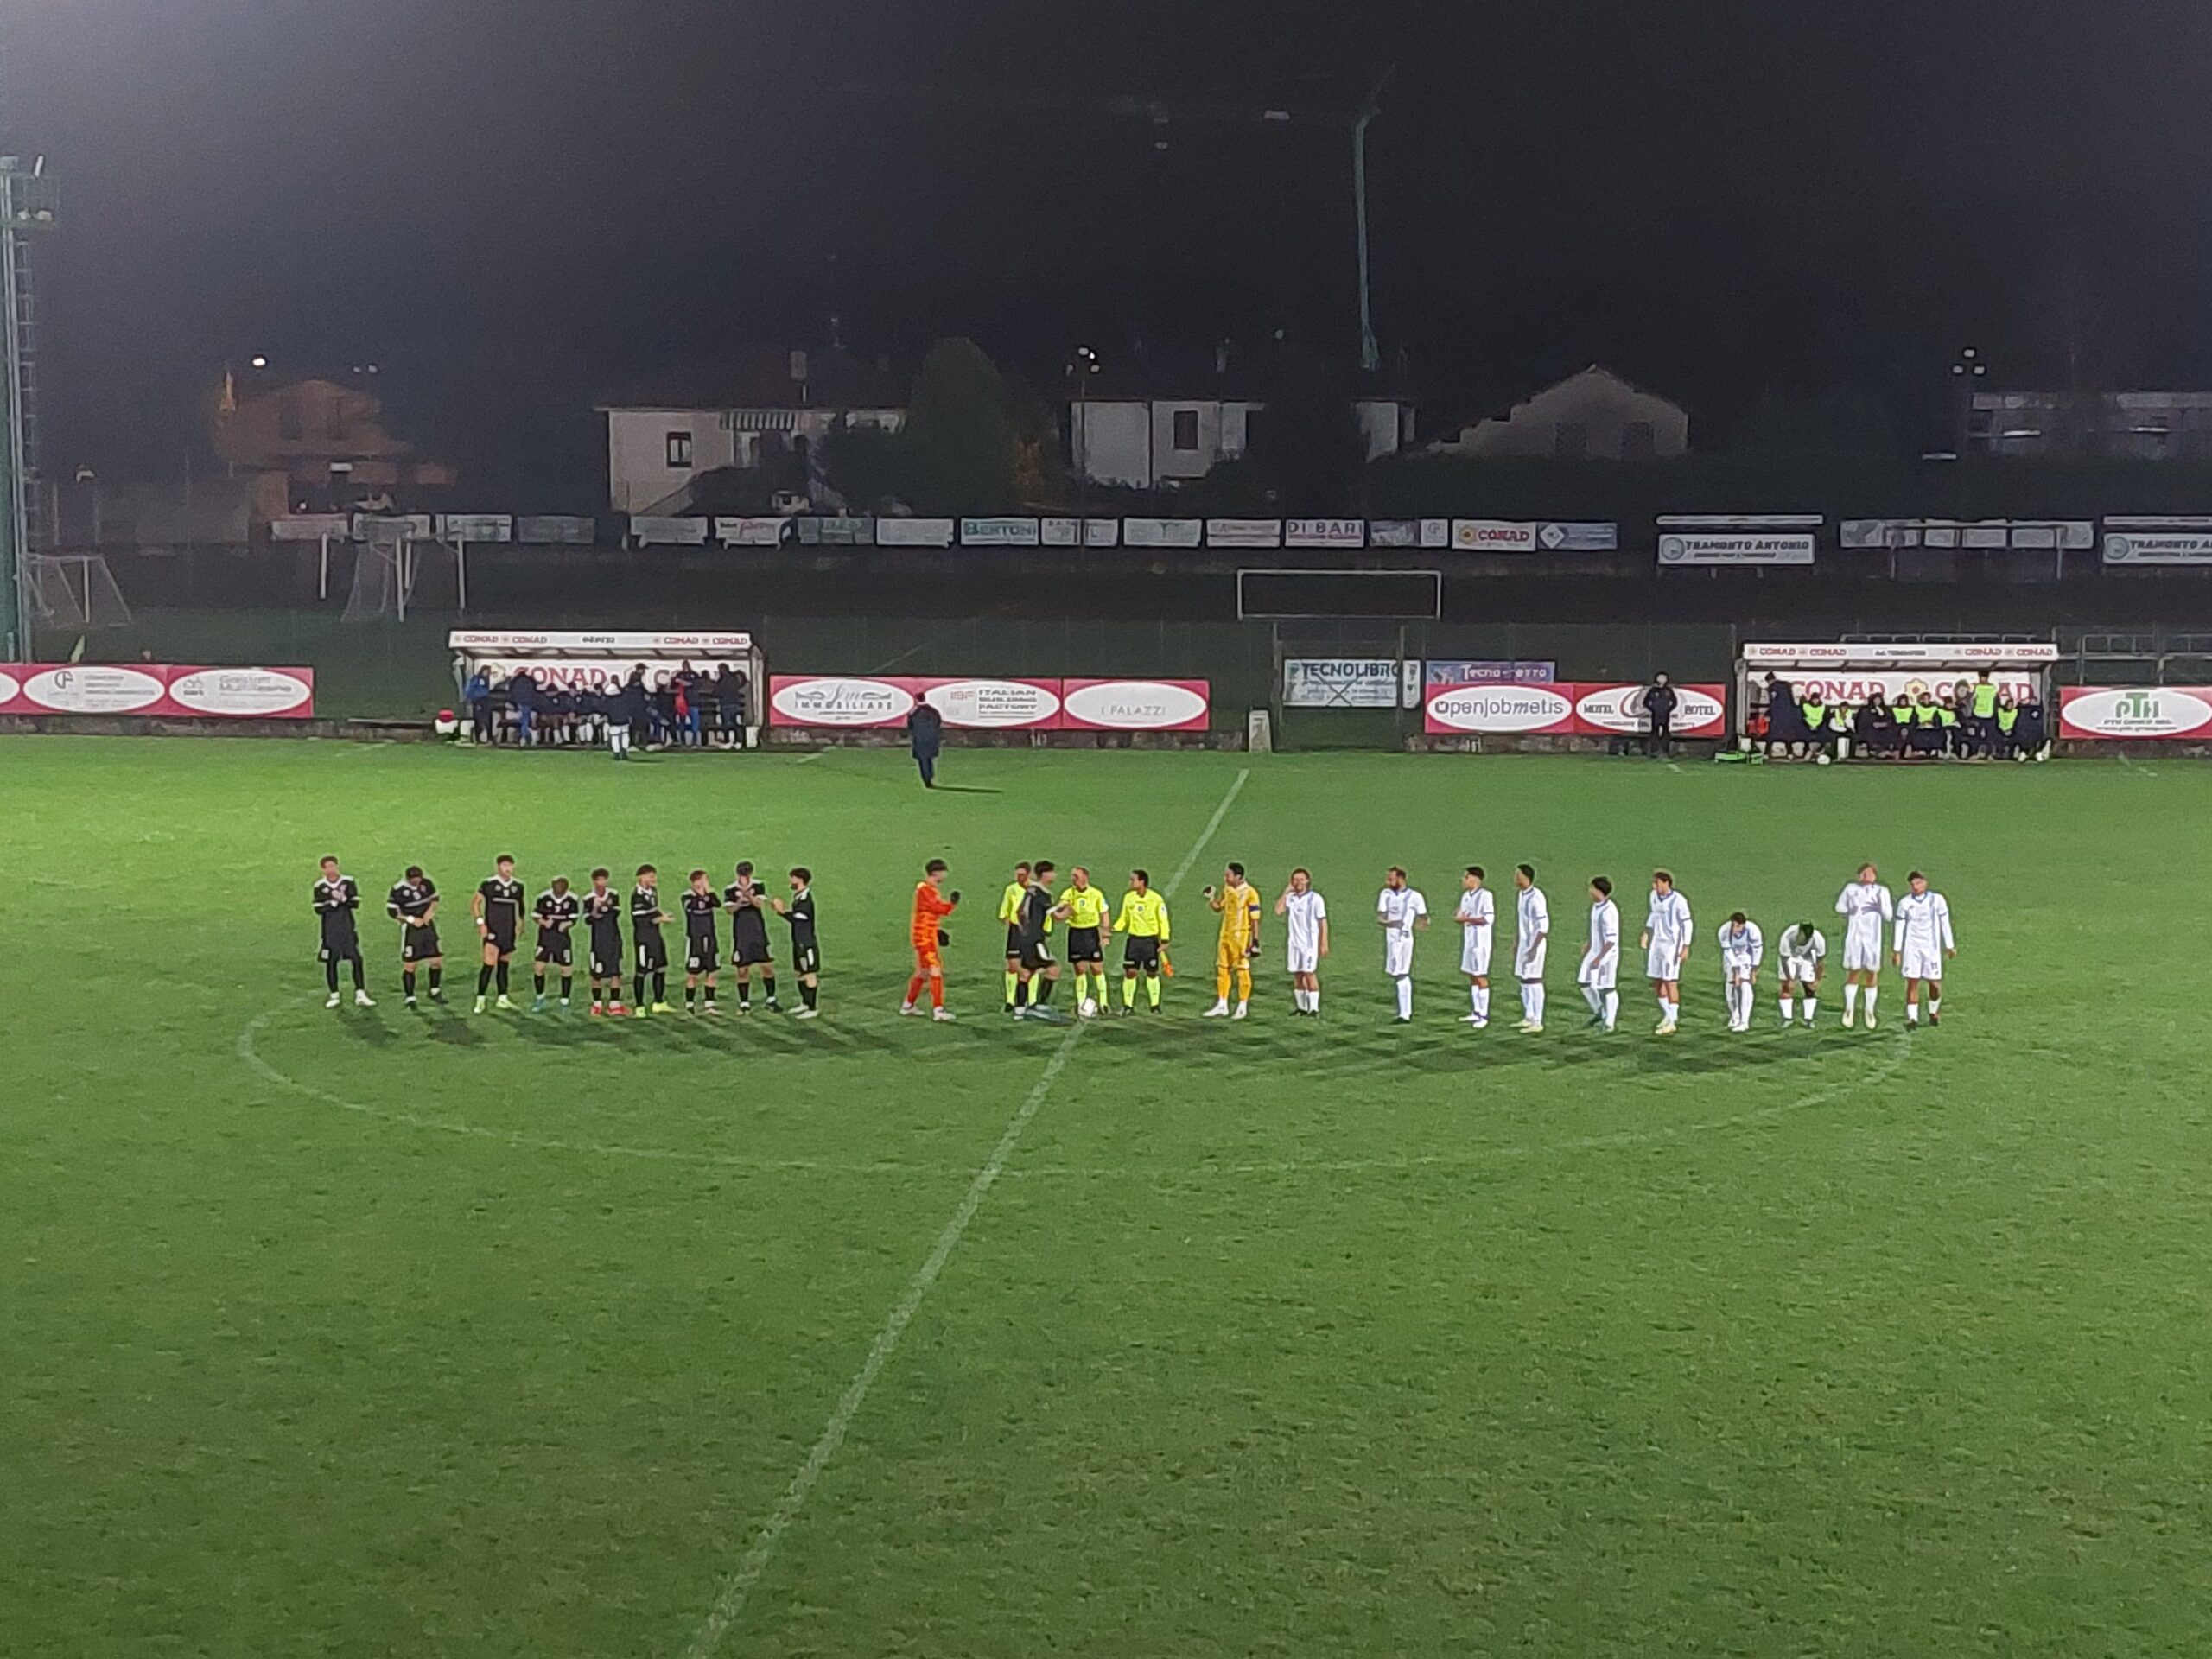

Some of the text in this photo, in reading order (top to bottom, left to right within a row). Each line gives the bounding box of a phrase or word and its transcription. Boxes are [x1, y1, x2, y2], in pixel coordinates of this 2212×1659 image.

[1287, 521, 1306, 533] DI
[1315, 521, 1363, 534] BARI
[1478, 529, 1530, 543] CONAD
[1686, 539, 1809, 550] TRAMONTO ANTONIO
[2129, 539, 2198, 550] TRAMONTO
[664, 636, 699, 645] CONAD
[1809, 648, 1847, 657] CONAD
[1964, 648, 2053, 657] CONAD CONAD
[1935, 681, 2037, 701] CAD
[795, 701, 892, 710] IMMOBILIARE
[1109, 705, 1166, 716] PALAZZI
[1584, 704, 1614, 714] MOTEL
